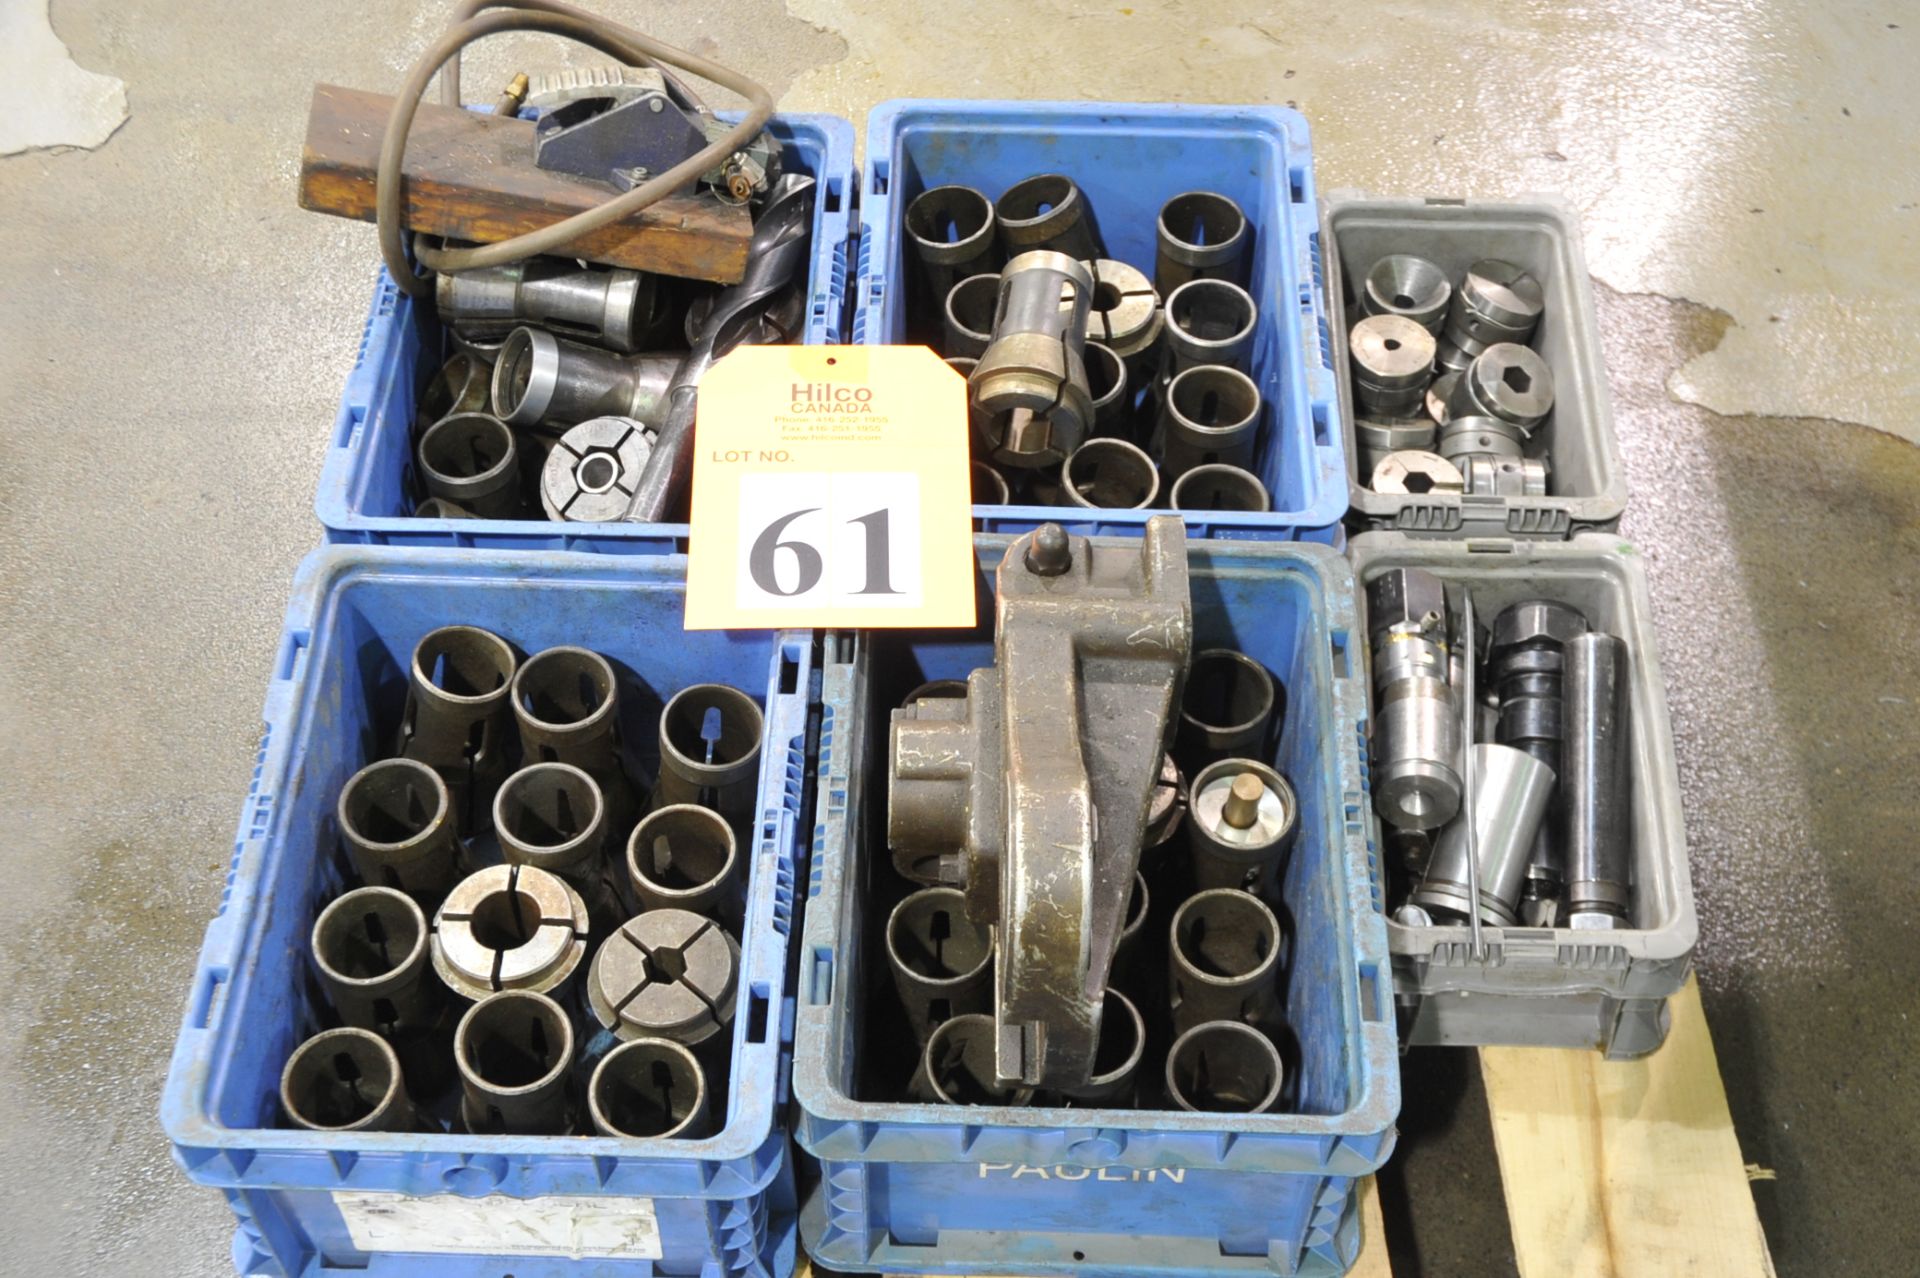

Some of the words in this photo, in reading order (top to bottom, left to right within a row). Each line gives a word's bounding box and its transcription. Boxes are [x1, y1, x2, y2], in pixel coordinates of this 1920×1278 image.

[791, 383, 873, 402] Hilco
[791, 403, 873, 414] CANADA
[712, 450, 752, 462] LOT
[760, 450, 795, 462] NO.
[749, 507, 907, 597] 61
